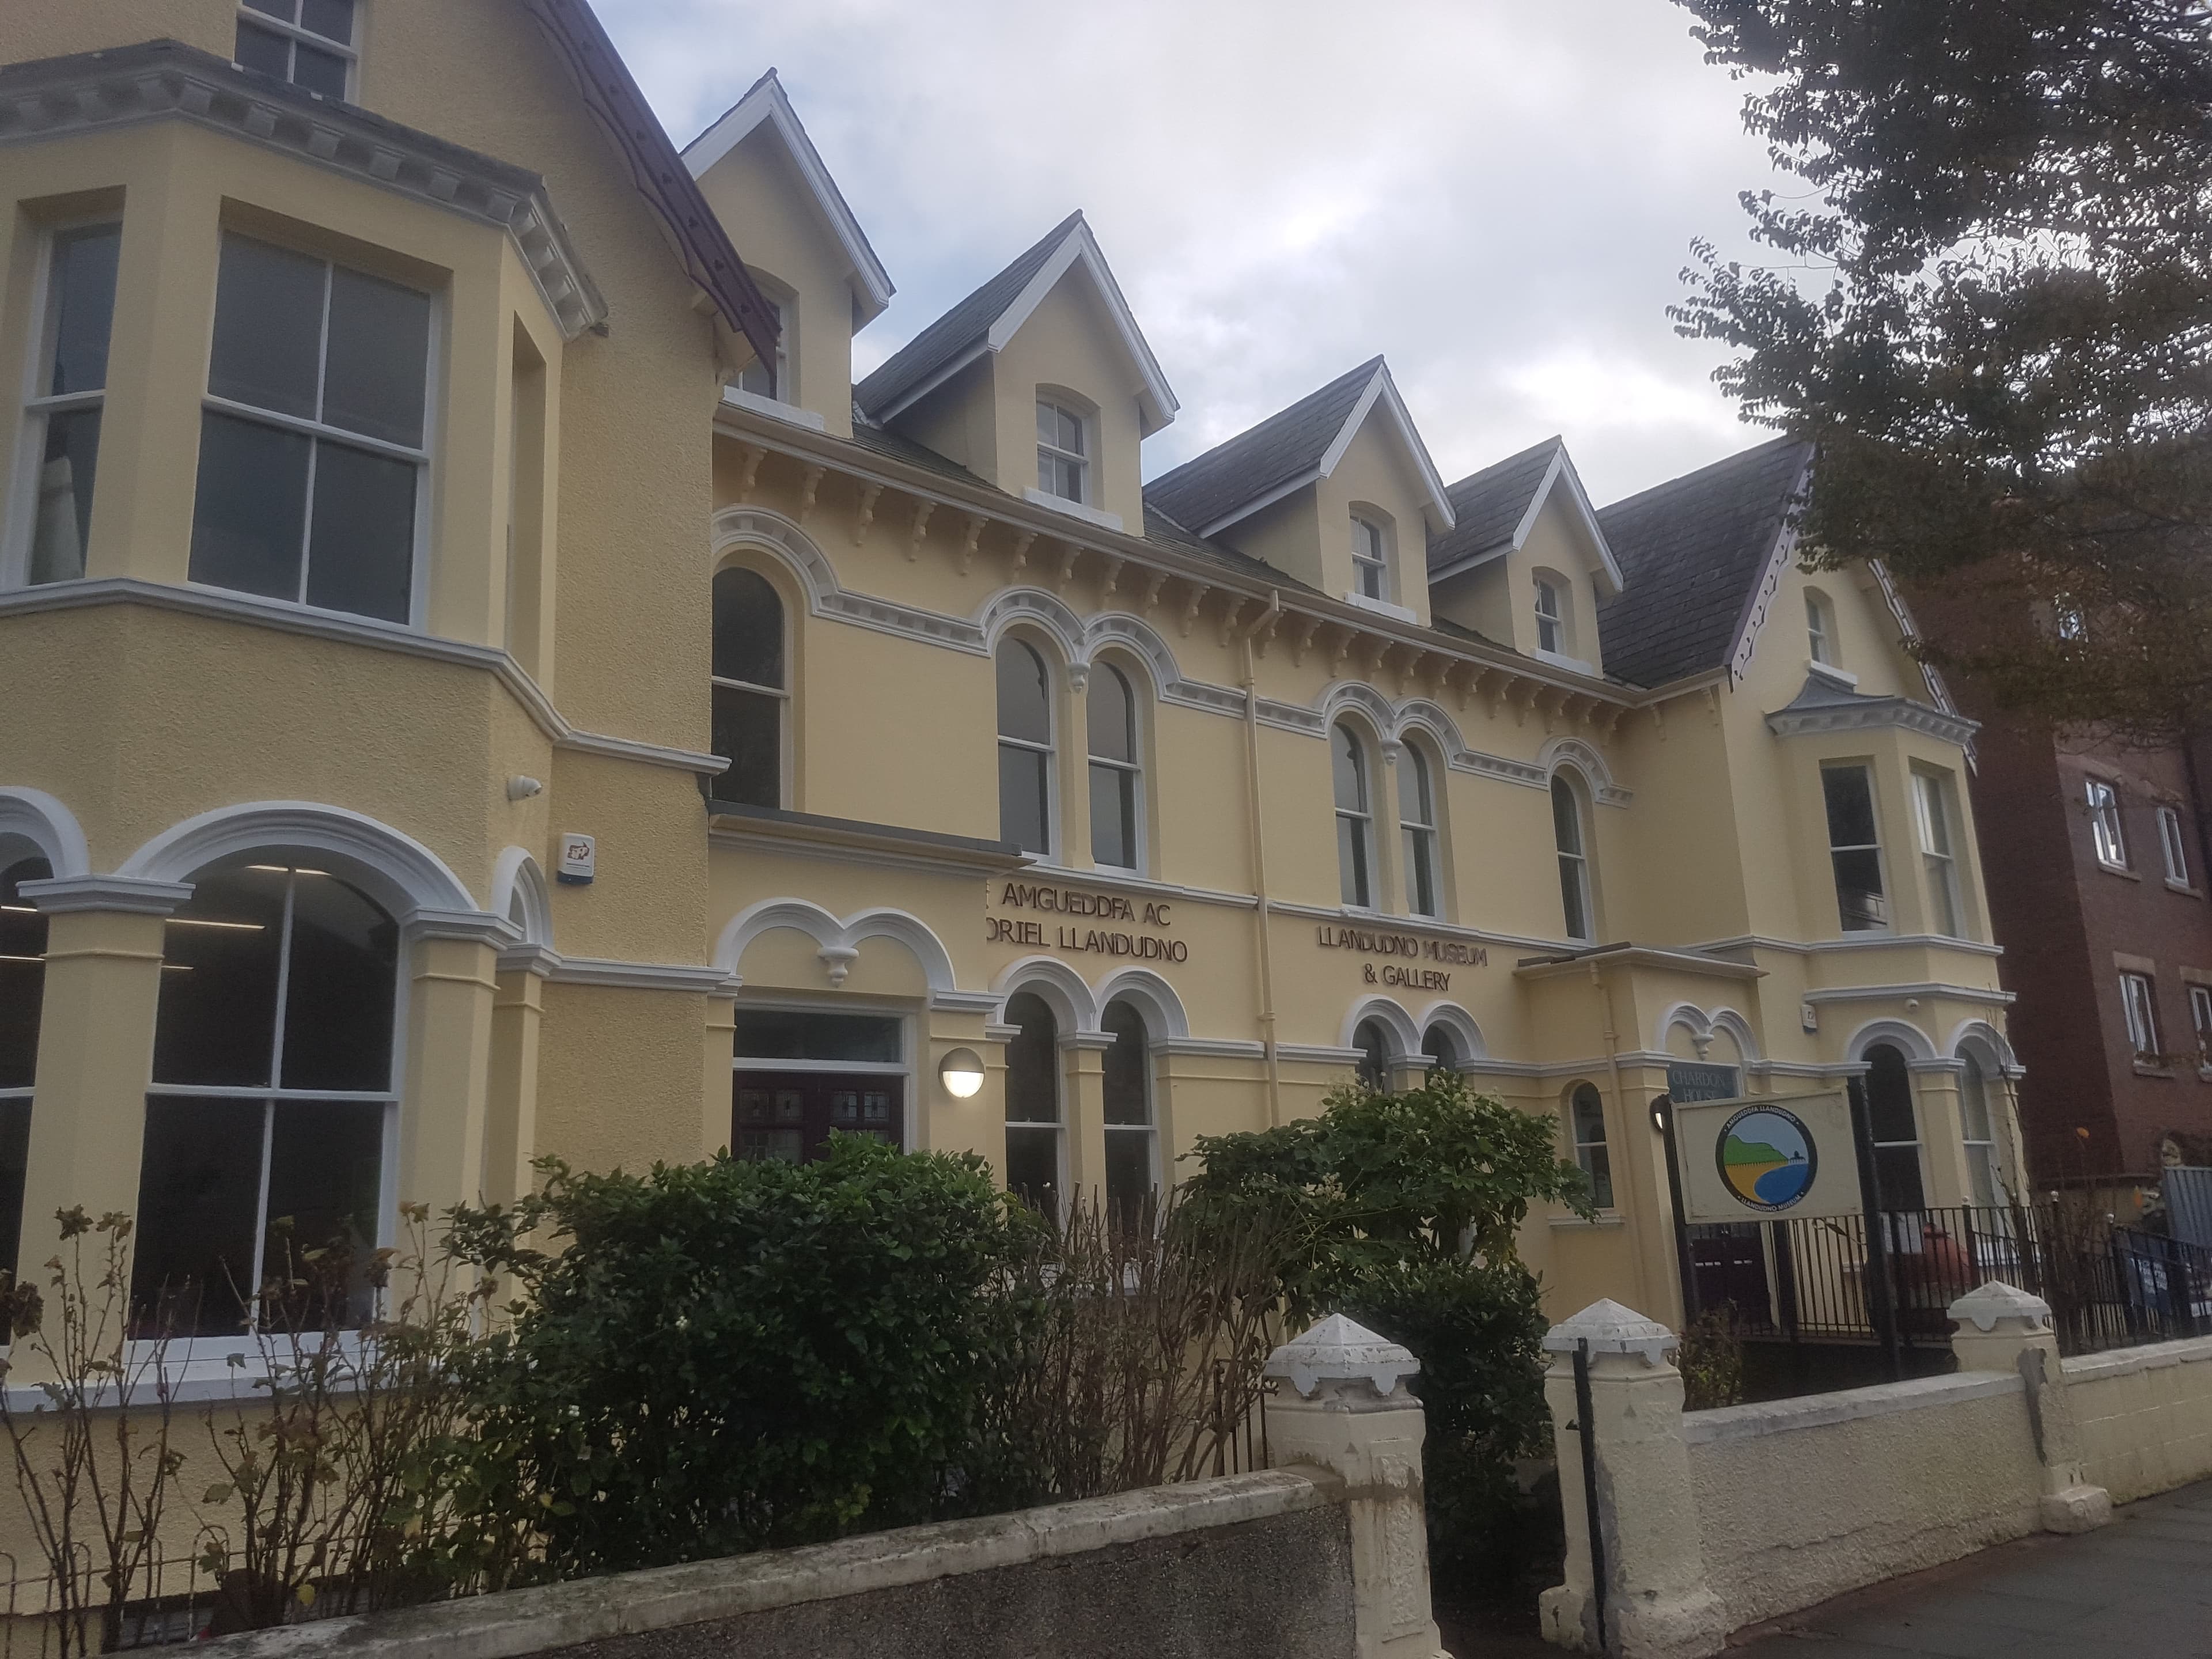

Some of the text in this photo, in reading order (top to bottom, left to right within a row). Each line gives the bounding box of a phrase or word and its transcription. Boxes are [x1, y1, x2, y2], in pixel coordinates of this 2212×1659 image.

[1002, 882, 1171, 926] AMGUEDDFA AC
[1059, 926, 1188, 963] LLANDUDNO
[1317, 926, 1488, 967] LLANDUDNO MUSEUM
[1363, 963, 1451, 991] & GALLERY
[1672, 1069, 1725, 1088] CHARDON
[1726, 1105, 1796, 1129] AMGUEDDFA LLANDUDNO
[1741, 1194, 1801, 1211] LLANDUDNO MUSEUM
